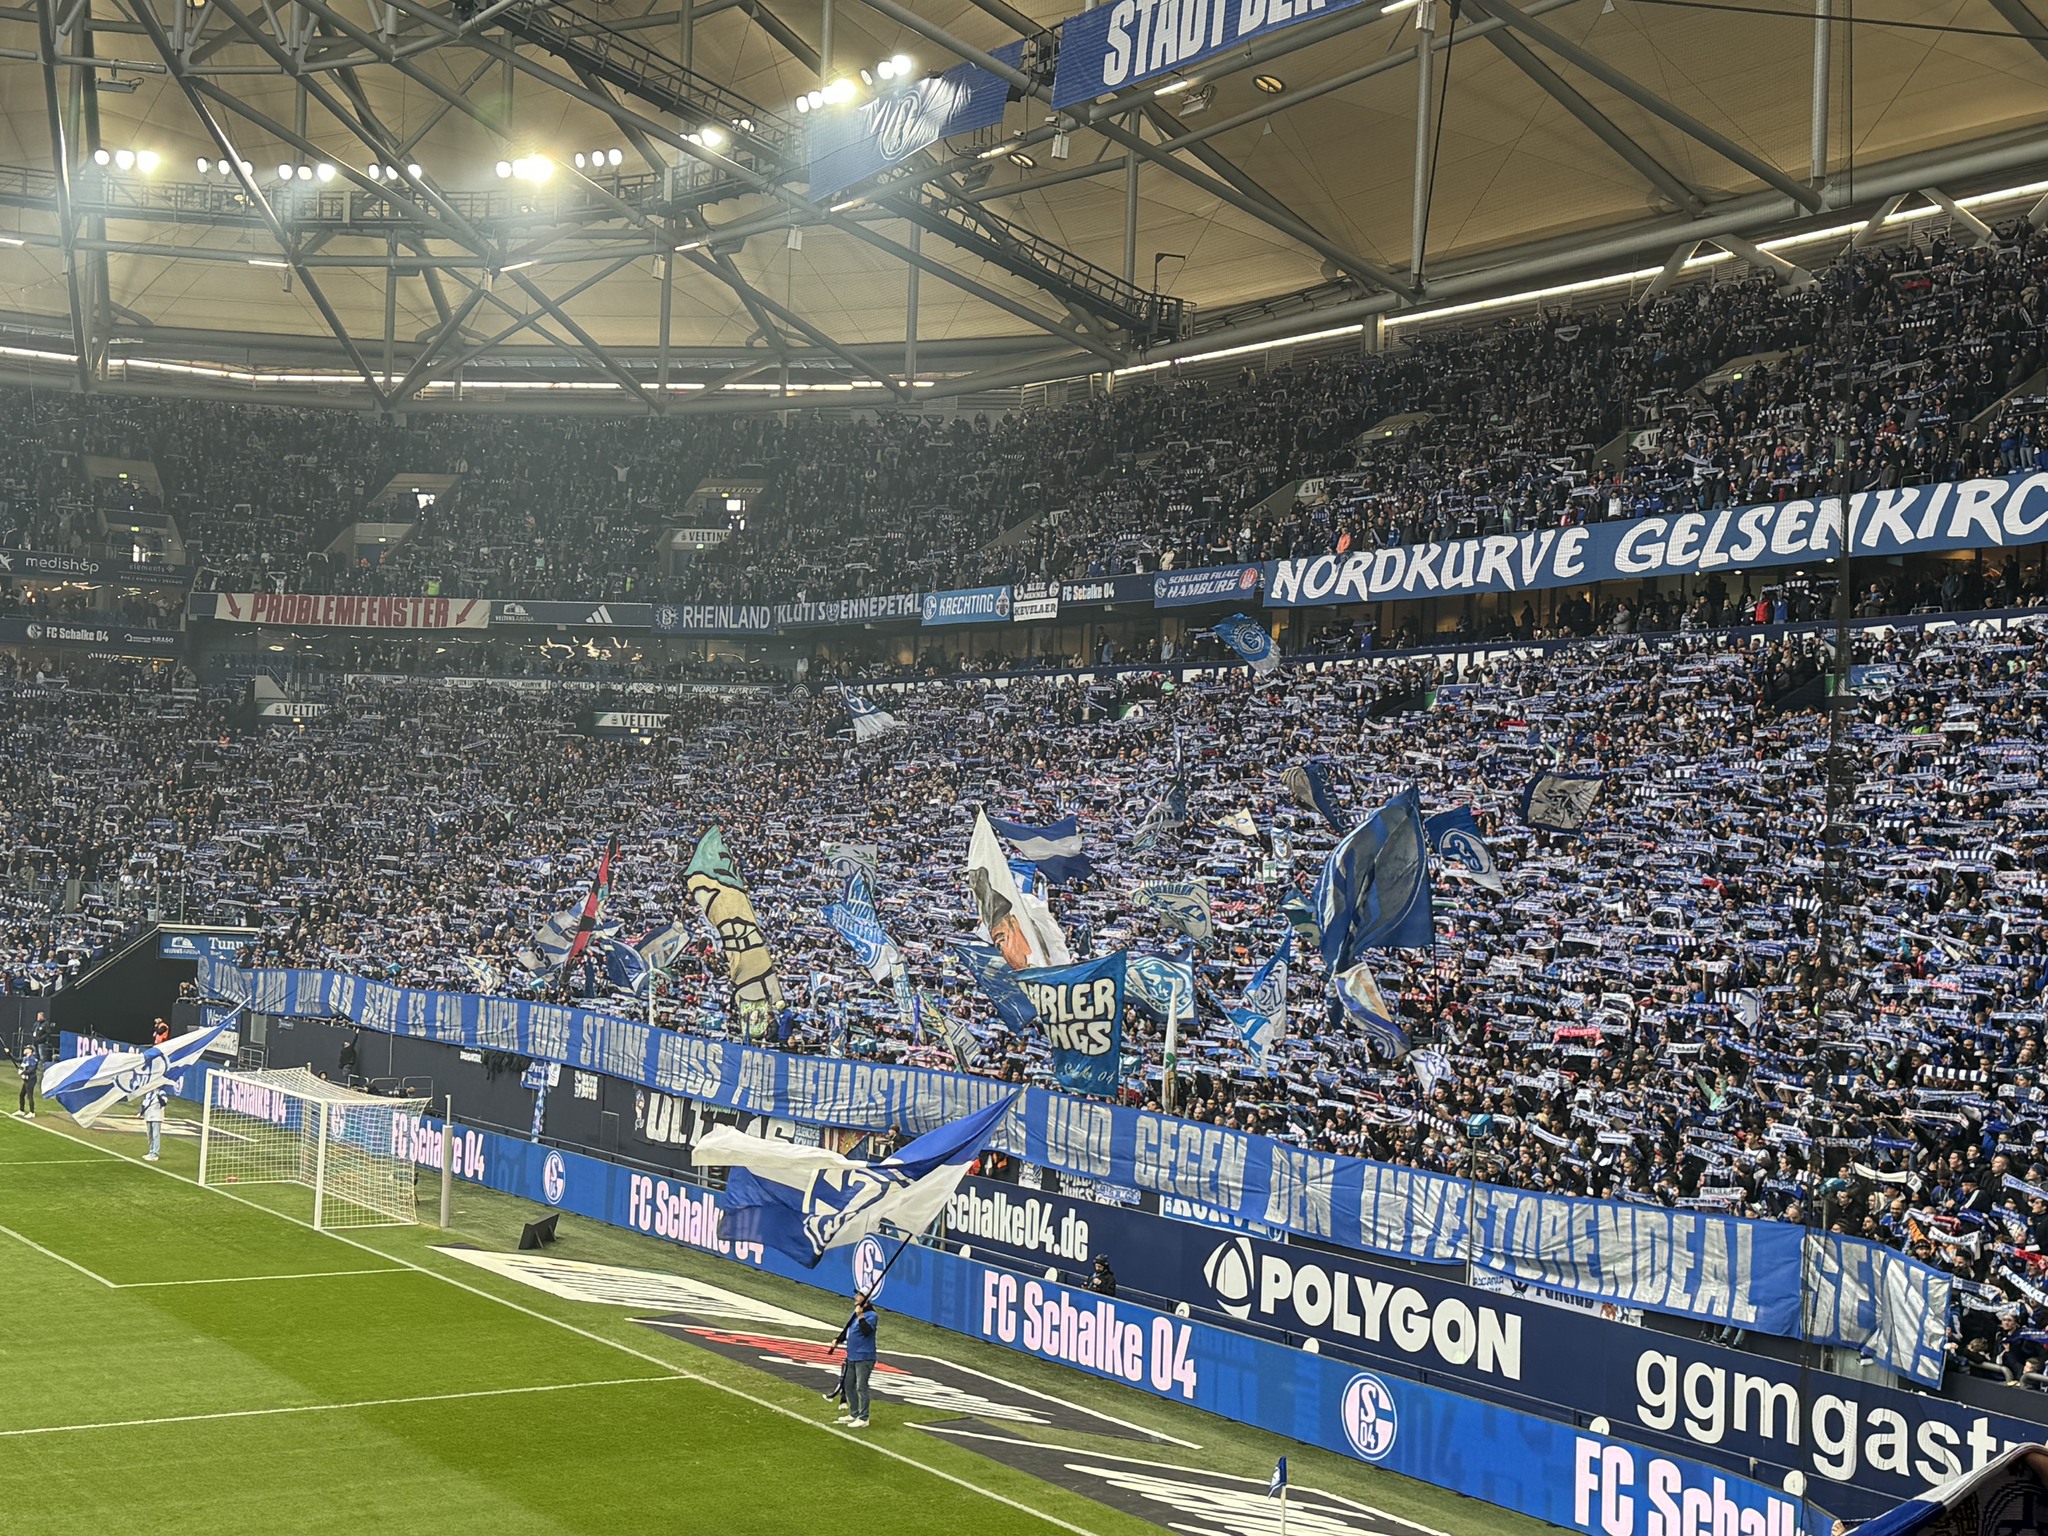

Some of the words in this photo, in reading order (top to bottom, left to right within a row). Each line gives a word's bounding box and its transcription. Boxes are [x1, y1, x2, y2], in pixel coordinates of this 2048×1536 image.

[26, 557, 99, 575] medishop
[1168, 572, 1209, 585] SCHALKER
[1210, 568, 1242, 580] FILIALE
[1270, 526, 1591, 603] NORDKURVE
[1062, 585, 1073, 602] FC
[1103, 582, 1115, 599] 04
[1167, 577, 1239, 599] HAMBURG
[250, 592, 450, 628] PROBLEMFENSTER
[682, 605, 771, 630] RHEINLAND
[839, 593, 922, 620] ENNEPETAL
[939, 594, 994, 616] KRECHTING
[46, 626, 57, 639] FC
[59, 628, 95, 641] Schalke
[96, 630, 109, 643] 04
[621, 713, 665, 727] VELTIN
[217, 1076, 231, 1108] FC
[390, 1111, 408, 1159] FC
[464, 1129, 485, 1181] 04
[580, 1014, 650, 1082] STIMME
[655, 1032, 724, 1099] MUSS
[731, 1049, 776, 1112] PRO
[1046, 1096, 1113, 1178] UND
[1134, 1114, 1248, 1212] GEGEN
[1263, 1144, 1335, 1238] DEN
[1359, 1164, 1759, 1324] INVESTORENDEAL
[629, 1173, 653, 1232] FC
[945, 1187, 1089, 1263] schalke04.de
[1260, 1254, 1522, 1381] POLYGON
[983, 1269, 1017, 1343] FC
[1024, 1279, 1143, 1382] Schalke
[1151, 1315, 1197, 1400] 04
[1574, 1436, 1635, 1536] FC
